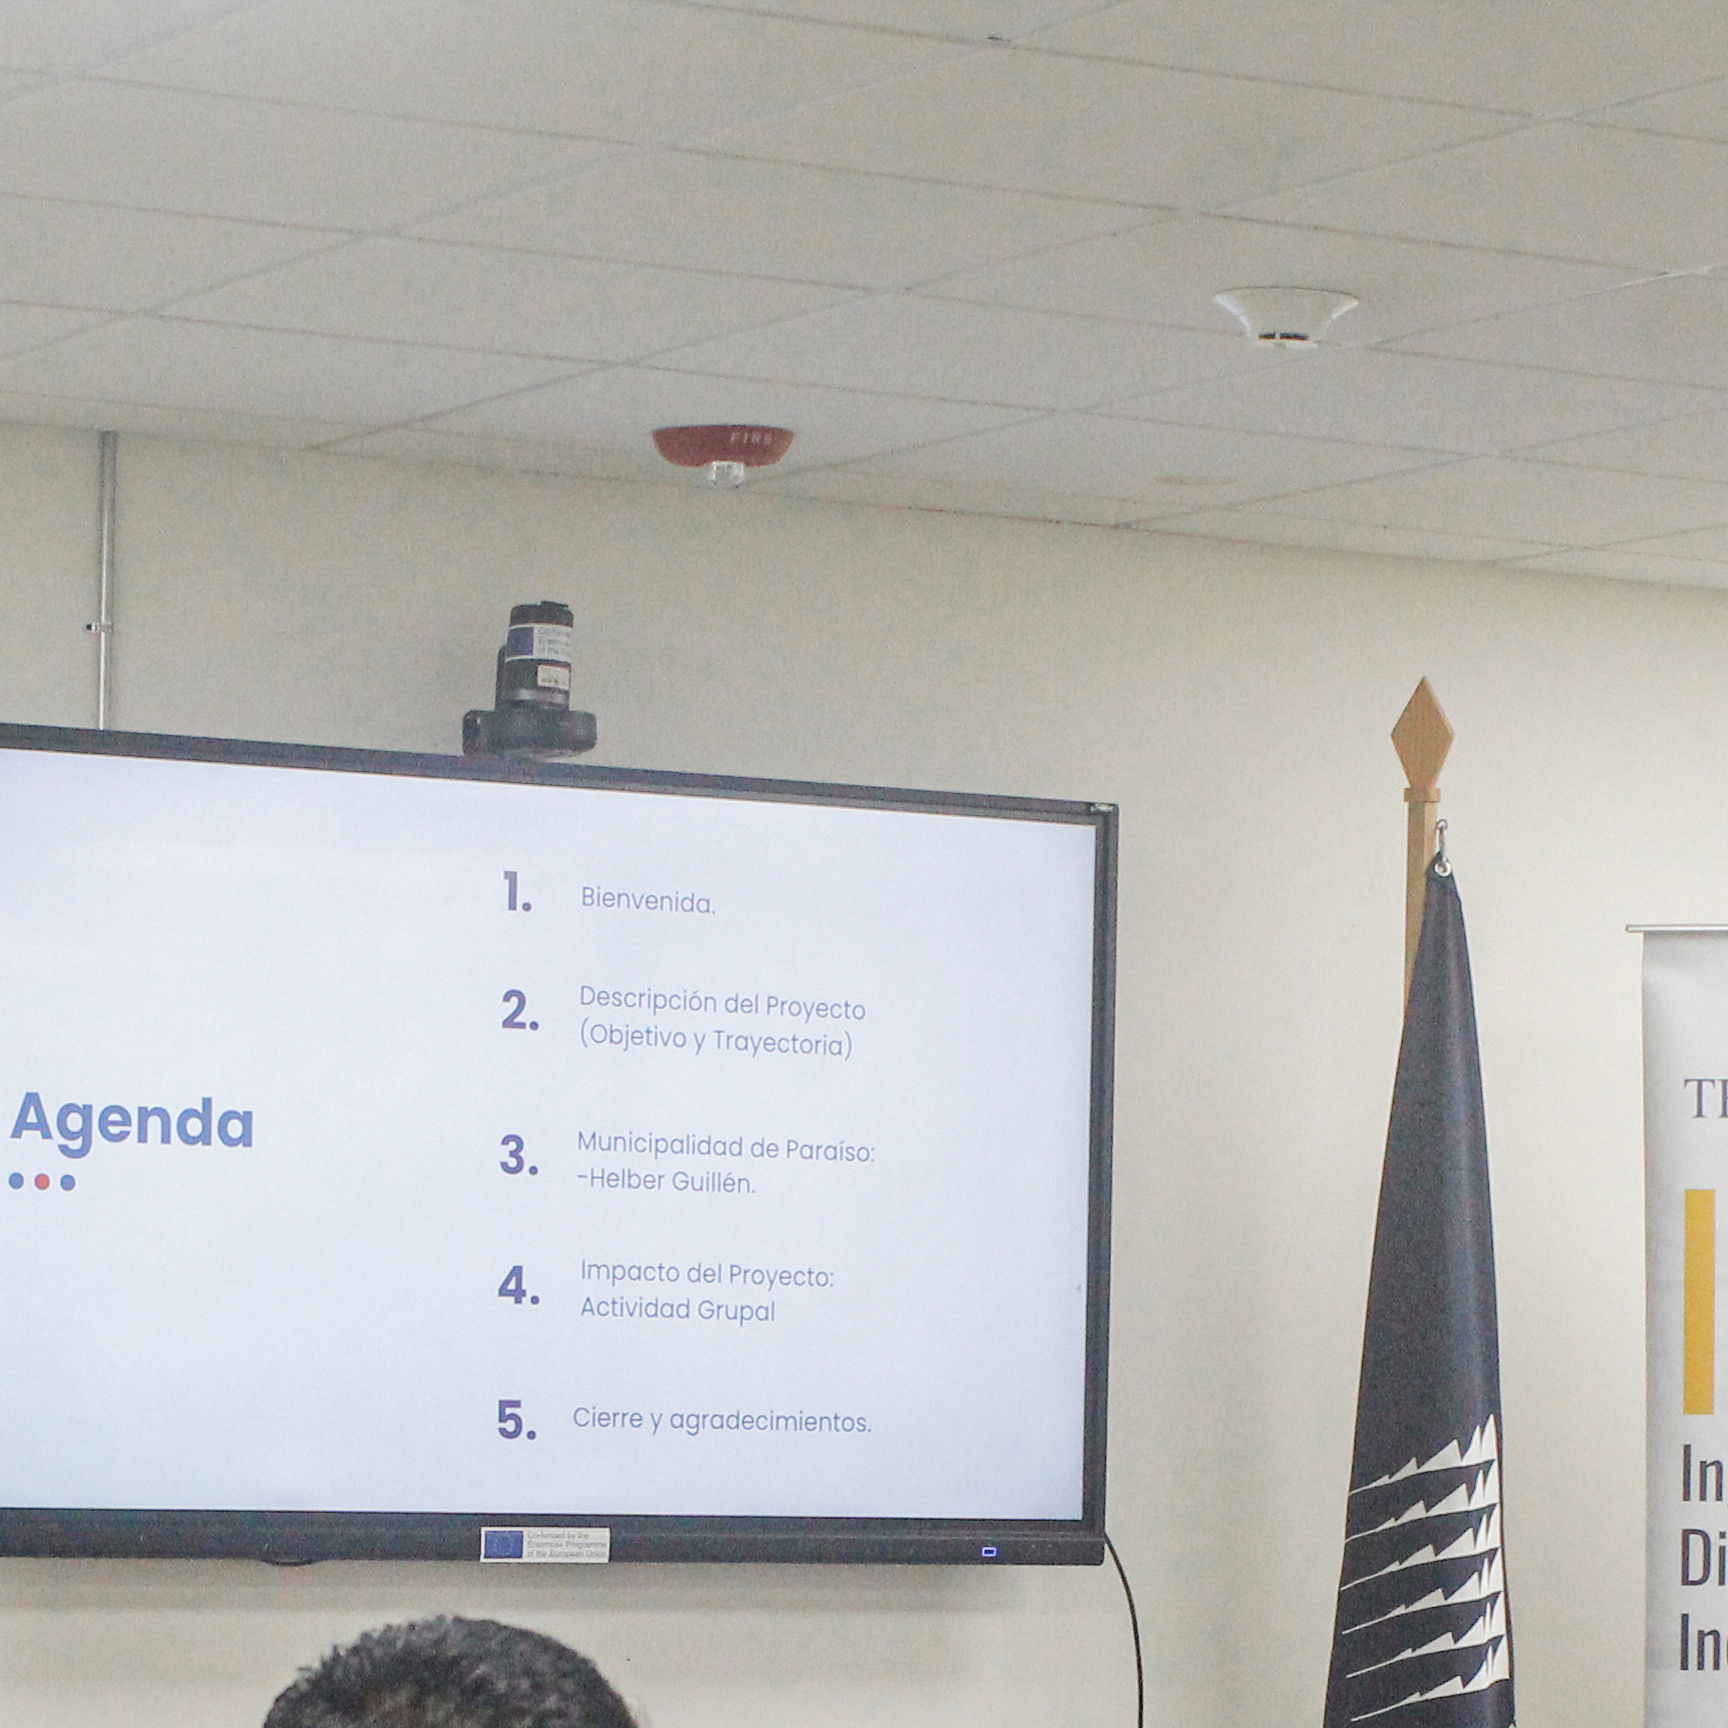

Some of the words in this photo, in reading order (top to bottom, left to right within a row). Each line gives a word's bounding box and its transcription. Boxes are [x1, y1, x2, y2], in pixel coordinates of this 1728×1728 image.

[730, 431, 773, 444] FIRE
[503, 870, 533, 912] 1.
[582, 886, 717, 915] Bienvenida.
[501, 989, 540, 1031] 2.
[580, 985, 717, 1016] Descripción
[724, 992, 759, 1014] del
[766, 995, 866, 1024] Proyecto
[580, 1016, 687, 1052] (Objetivo
[693, 1031, 706, 1056] y
[713, 1029, 853, 1061] Trayectoria)
[9, 1091, 254, 1160] Agenda
[499, 1133, 539, 1176] 3.
[577, 1130, 743, 1160] Municipalidad
[750, 1137, 779, 1159] de
[786, 1138, 876, 1163] Paraíso:
[577, 1167, 665, 1191] -Helber
[672, 1171, 756, 1195] Guillén.
[497, 1264, 541, 1305] 4.
[581, 1258, 680, 1287] Impacto
[686, 1261, 722, 1284] del
[729, 1264, 835, 1292] Proyecto:
[580, 1296, 691, 1319] Actividad
[697, 1299, 776, 1327] Grupal
[497, 1399, 537, 1440] 5.
[572, 1406, 643, 1429] Cierre
[650, 1412, 663, 1436] y
[669, 1409, 872, 1437] agradecimientos.
